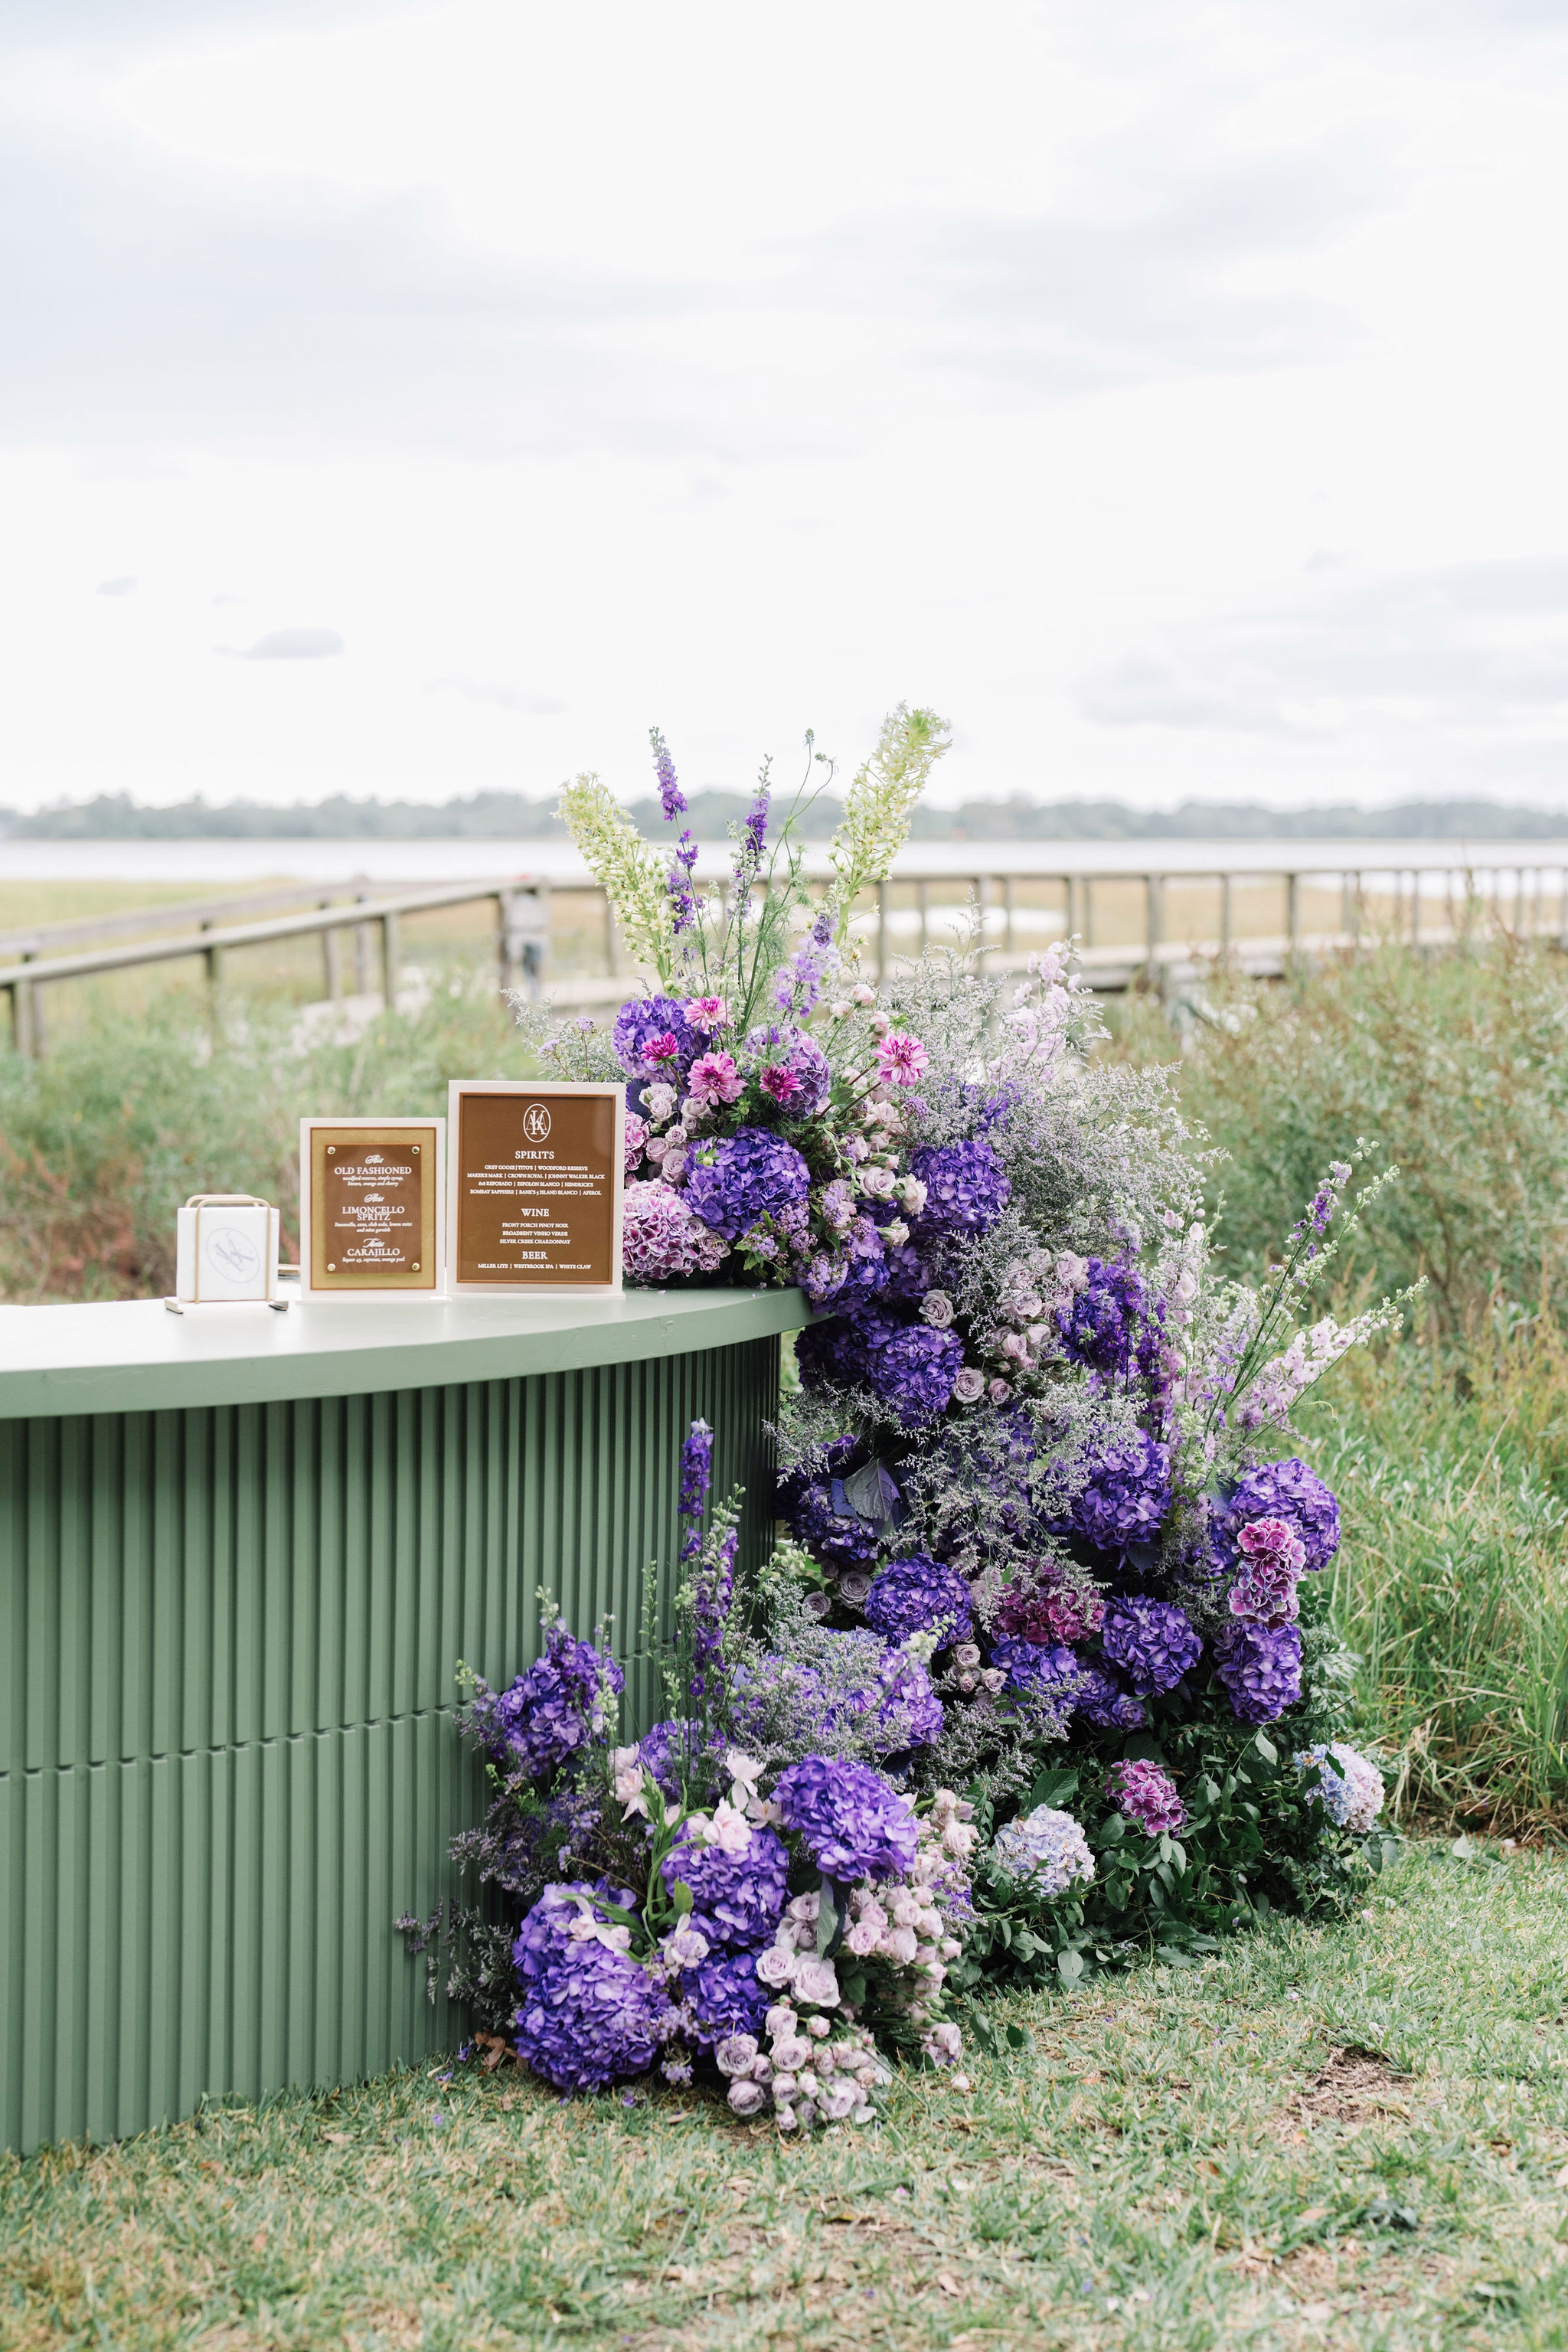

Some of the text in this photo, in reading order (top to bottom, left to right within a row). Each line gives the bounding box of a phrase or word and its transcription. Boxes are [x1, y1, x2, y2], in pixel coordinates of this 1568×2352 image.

[514, 1151, 555, 1160] SPIRITS
[334, 1166, 412, 1175] OLD FASHIONED
[341, 1206, 406, 1214] LIMONCELLO
[521, 1208, 550, 1217] WINE
[347, 1248, 400, 1258] CARAJILLO
[521, 1251, 549, 1260] BEER
